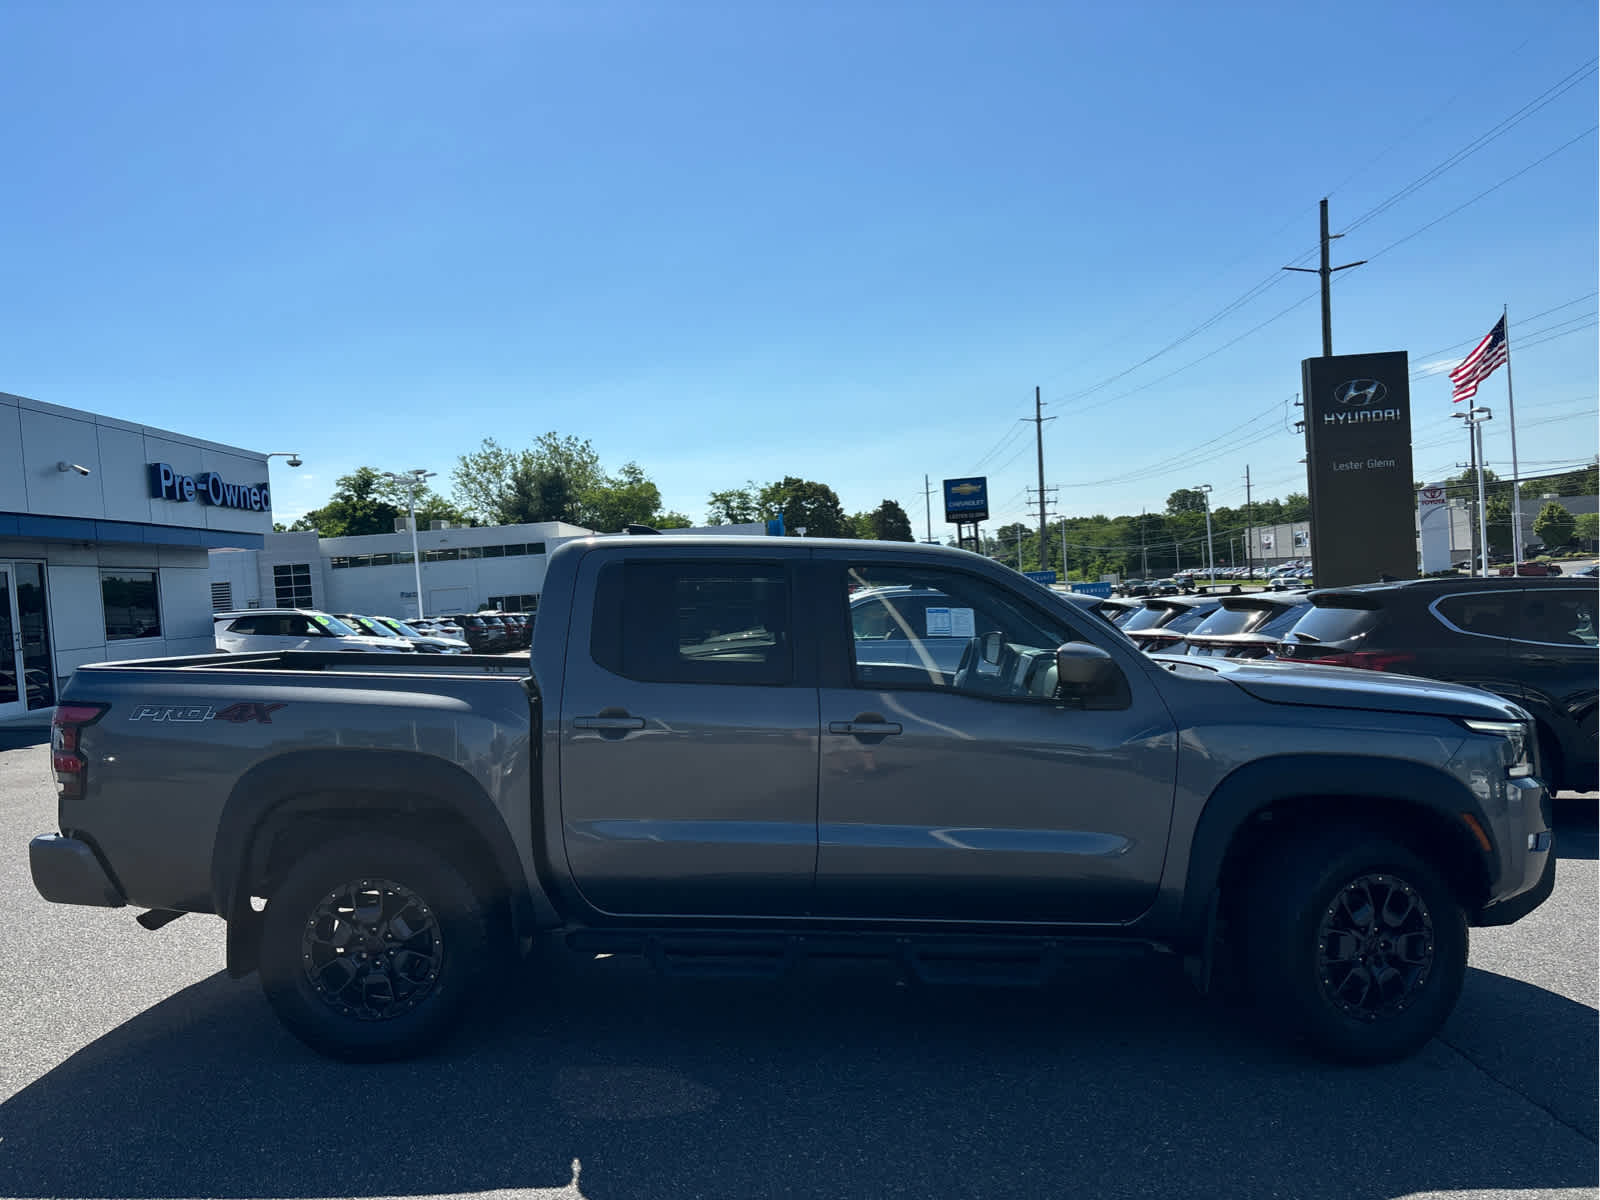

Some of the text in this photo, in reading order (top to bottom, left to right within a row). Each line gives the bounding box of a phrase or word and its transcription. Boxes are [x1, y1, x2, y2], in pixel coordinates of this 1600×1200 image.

[1323, 408, 1401, 425] HYUNDAI
[1333, 459, 1395, 471] Lester Glenn
[156, 462, 272, 512] Pre-Owned
